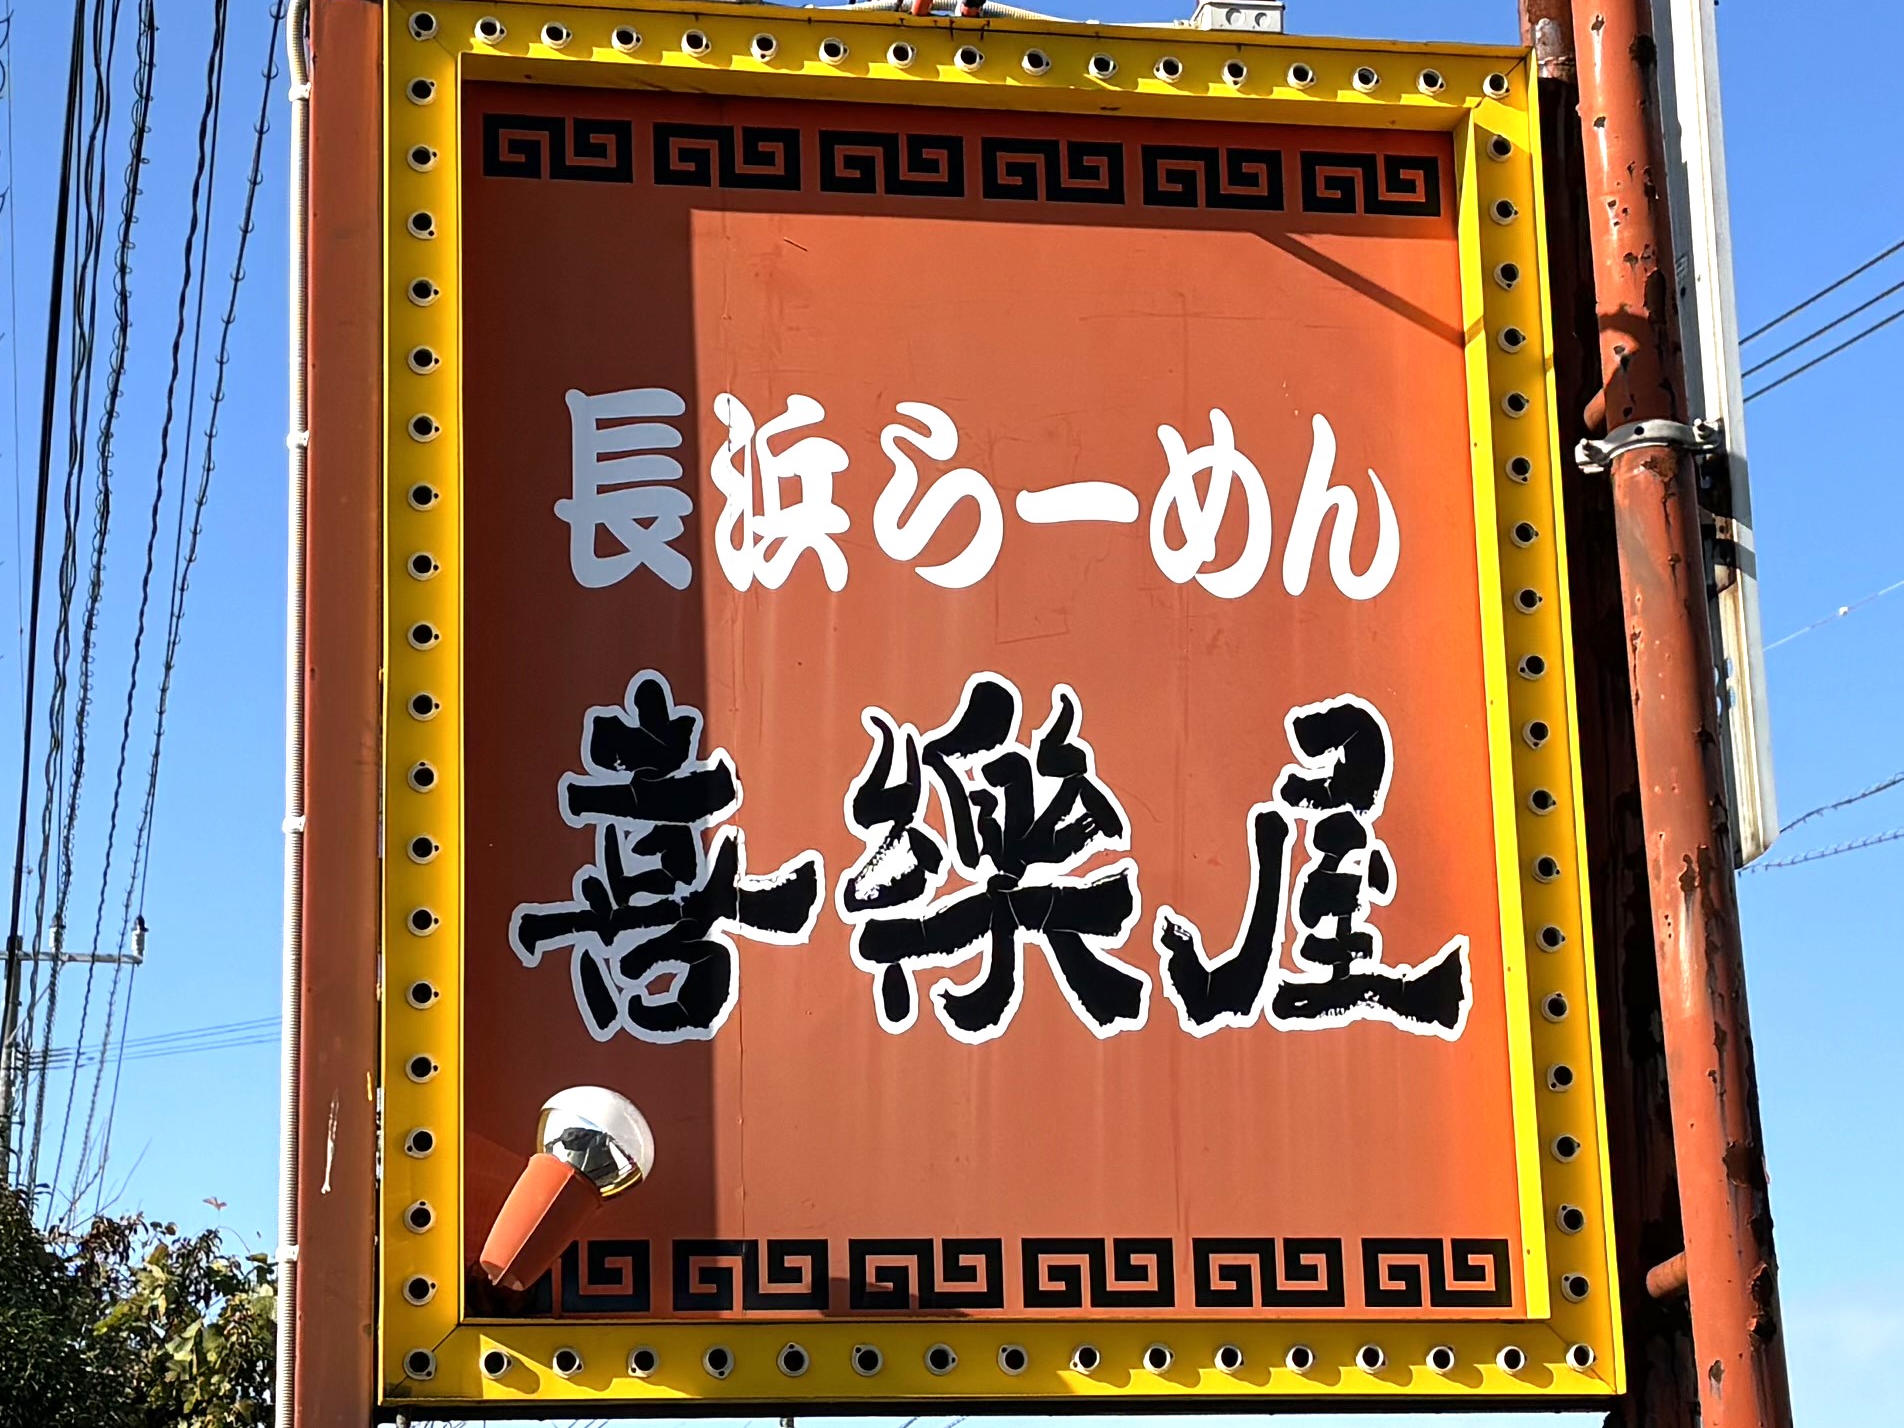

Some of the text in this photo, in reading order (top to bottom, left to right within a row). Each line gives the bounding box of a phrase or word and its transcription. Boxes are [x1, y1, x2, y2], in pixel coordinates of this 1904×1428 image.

[553, 387, 1400, 600] 長浜らーめん
